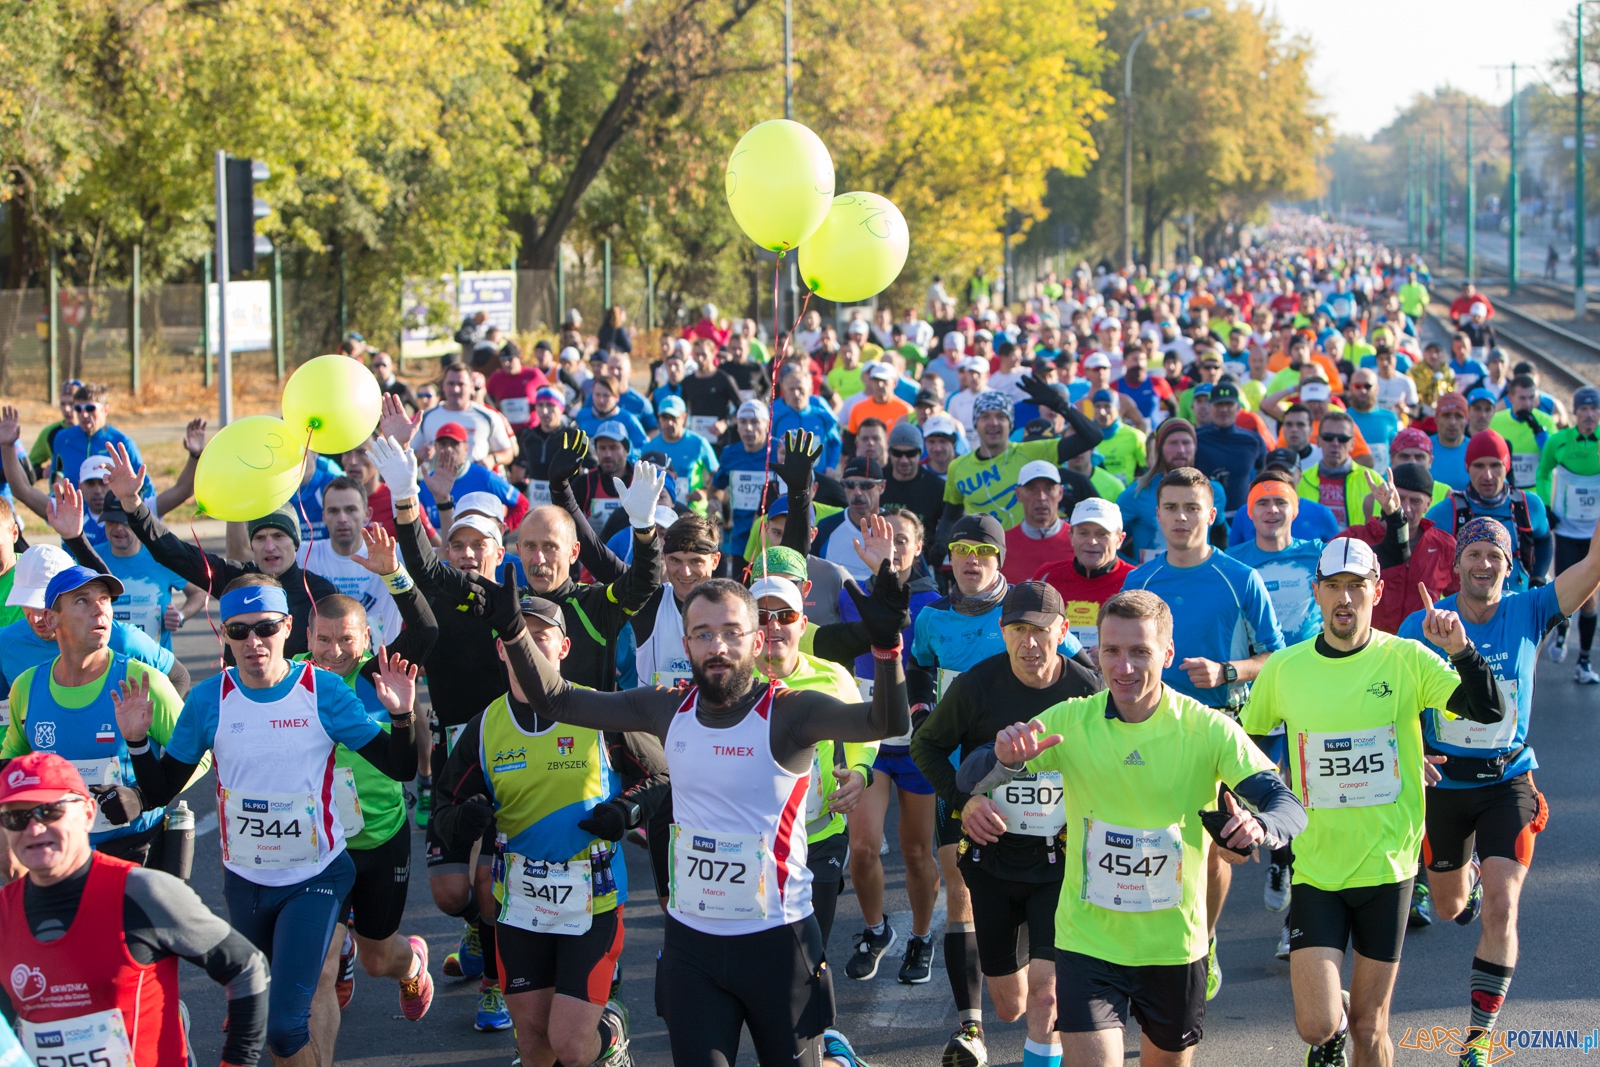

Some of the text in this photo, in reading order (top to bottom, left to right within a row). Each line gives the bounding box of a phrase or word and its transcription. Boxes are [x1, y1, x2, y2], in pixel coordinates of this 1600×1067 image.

[957, 464, 1001, 496] RUN
[1579, 496, 1595, 506] 50
[270, 718, 309, 728] TIMEX
[1326, 741, 1350, 749] 16.PKO
[713, 746, 754, 757] TIMEX
[547, 760, 587, 770] ZBYSZEK
[1319, 753, 1384, 777] 3345
[1339, 781, 1369, 789] Grzegorz
[1006, 786, 1064, 805] 6307
[244, 802, 267, 810] 16.PKO
[237, 816, 302, 838] 7344
[694, 840, 714, 849] 16.PKO
[1107, 835, 1131, 845] 16.PKO
[687, 856, 746, 884] 7072
[1099, 853, 1168, 877] 4547
[1117, 882, 1145, 891] Norbert
[522, 881, 573, 904] 3417
[702, 888, 725, 896] Marcin
[535, 905, 559, 916] Zbigniew
[50, 983, 88, 994] KRWINKA
